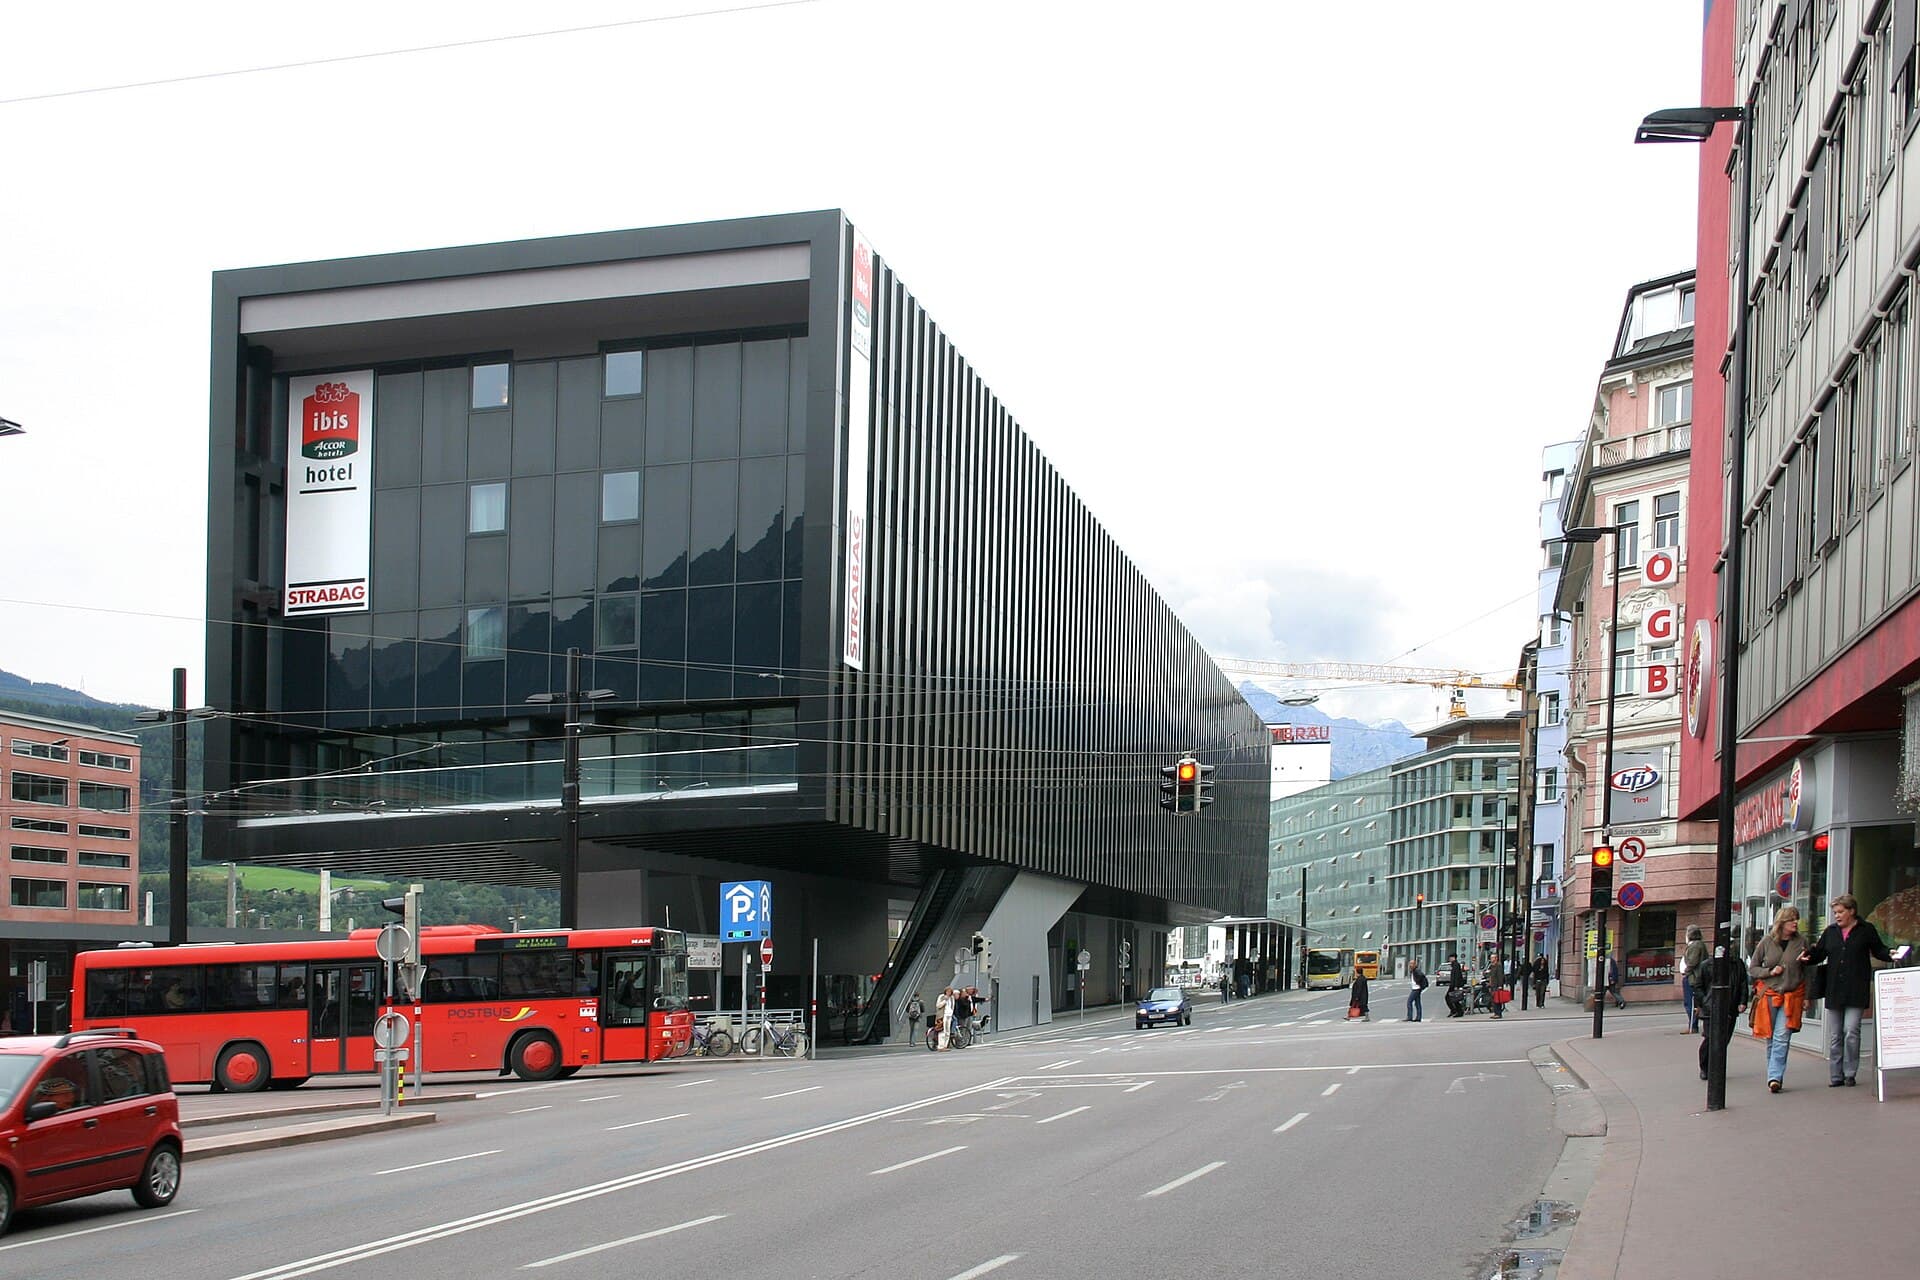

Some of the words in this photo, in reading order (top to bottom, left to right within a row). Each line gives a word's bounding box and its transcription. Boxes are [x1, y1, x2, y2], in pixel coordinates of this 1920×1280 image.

[313, 410, 349, 431] ibis
[317, 449, 343, 458] hotels
[306, 462, 353, 484] hotel
[288, 585, 366, 605] STRABAG
[850, 515, 861, 660] STRABAG
[1620, 771, 1646, 791] bfi
[1633, 796, 1649, 804] Tirol
[448, 1007, 512, 1018] POSTBUS
